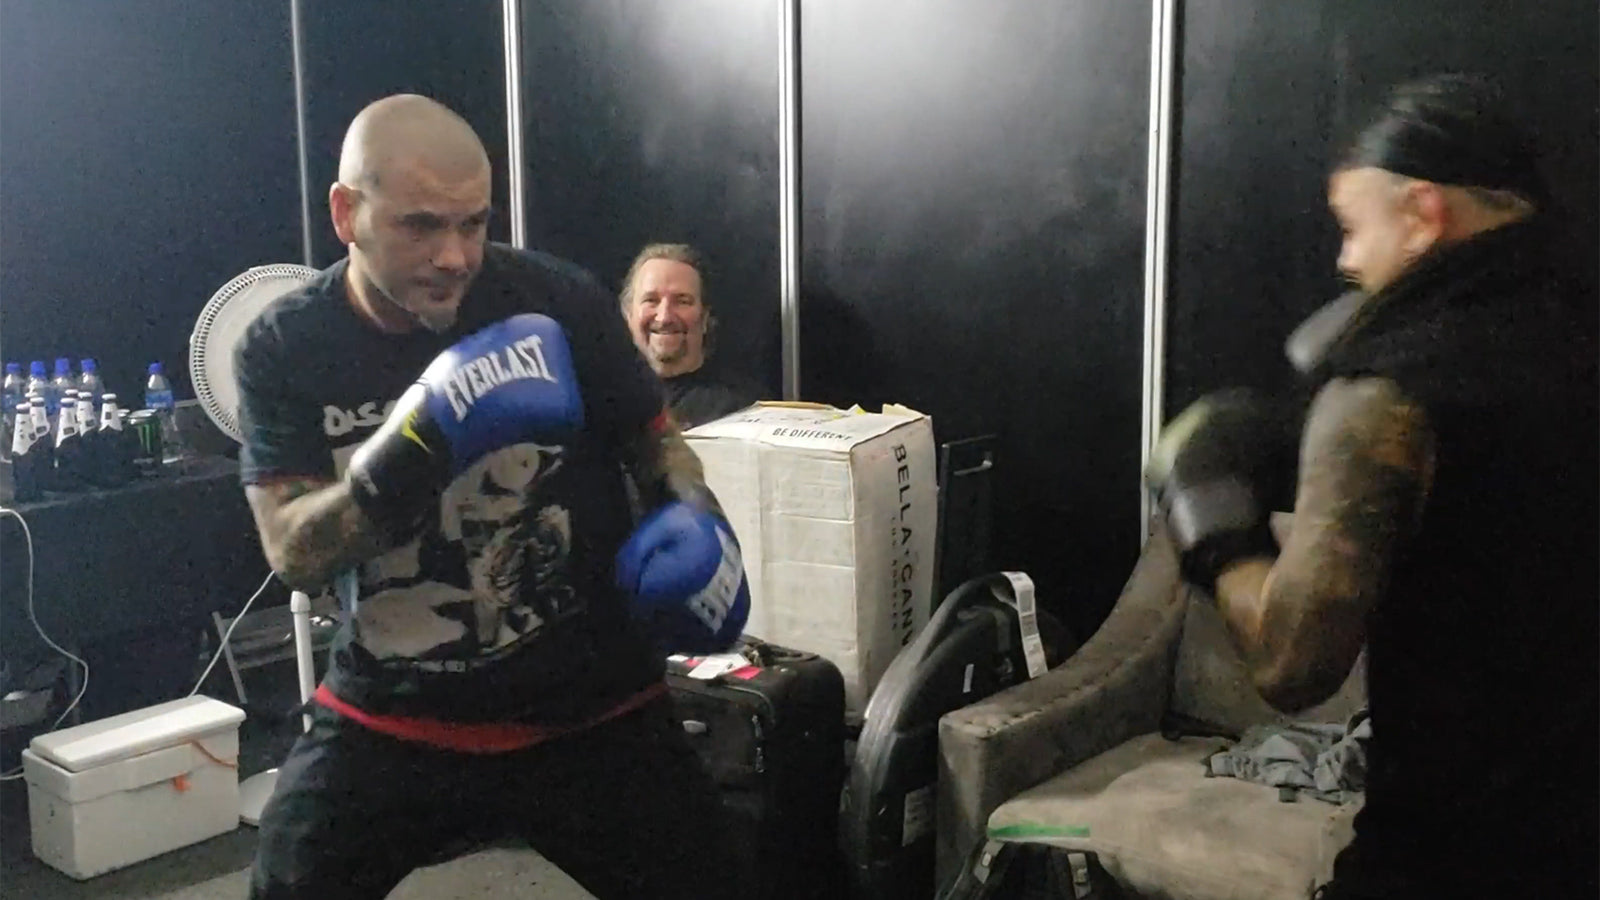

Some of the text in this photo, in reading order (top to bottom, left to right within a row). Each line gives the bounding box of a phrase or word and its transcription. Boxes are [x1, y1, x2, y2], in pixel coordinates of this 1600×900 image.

[445, 334, 557, 423] EVERLAST
[772, 427, 853, 441] BE DIFFERENT
